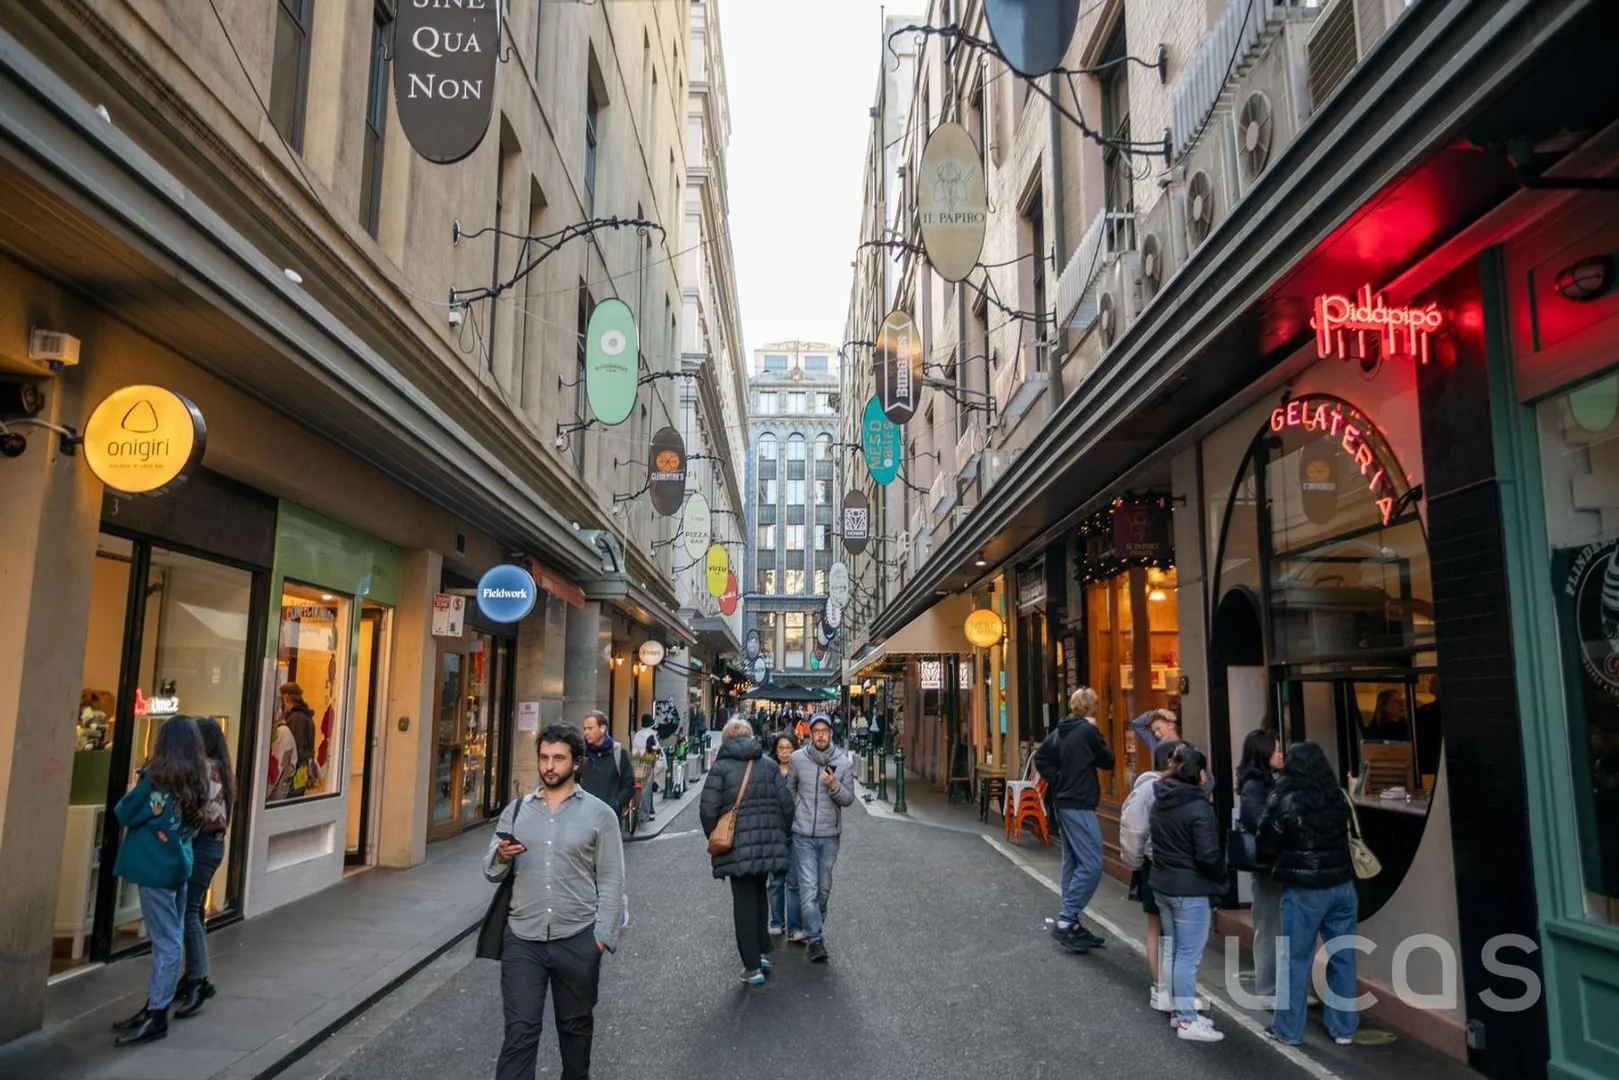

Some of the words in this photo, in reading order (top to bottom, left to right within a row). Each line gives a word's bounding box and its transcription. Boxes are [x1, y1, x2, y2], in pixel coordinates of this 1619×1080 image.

[923, 213, 936, 224] IL
[939, 211, 986, 224] PAPIRO
[107, 438, 170, 462] onigiri
[1270, 400, 1396, 525] GELATERIA
[113, 499, 120, 516] 3
[482, 587, 528, 600] Fieldwork
